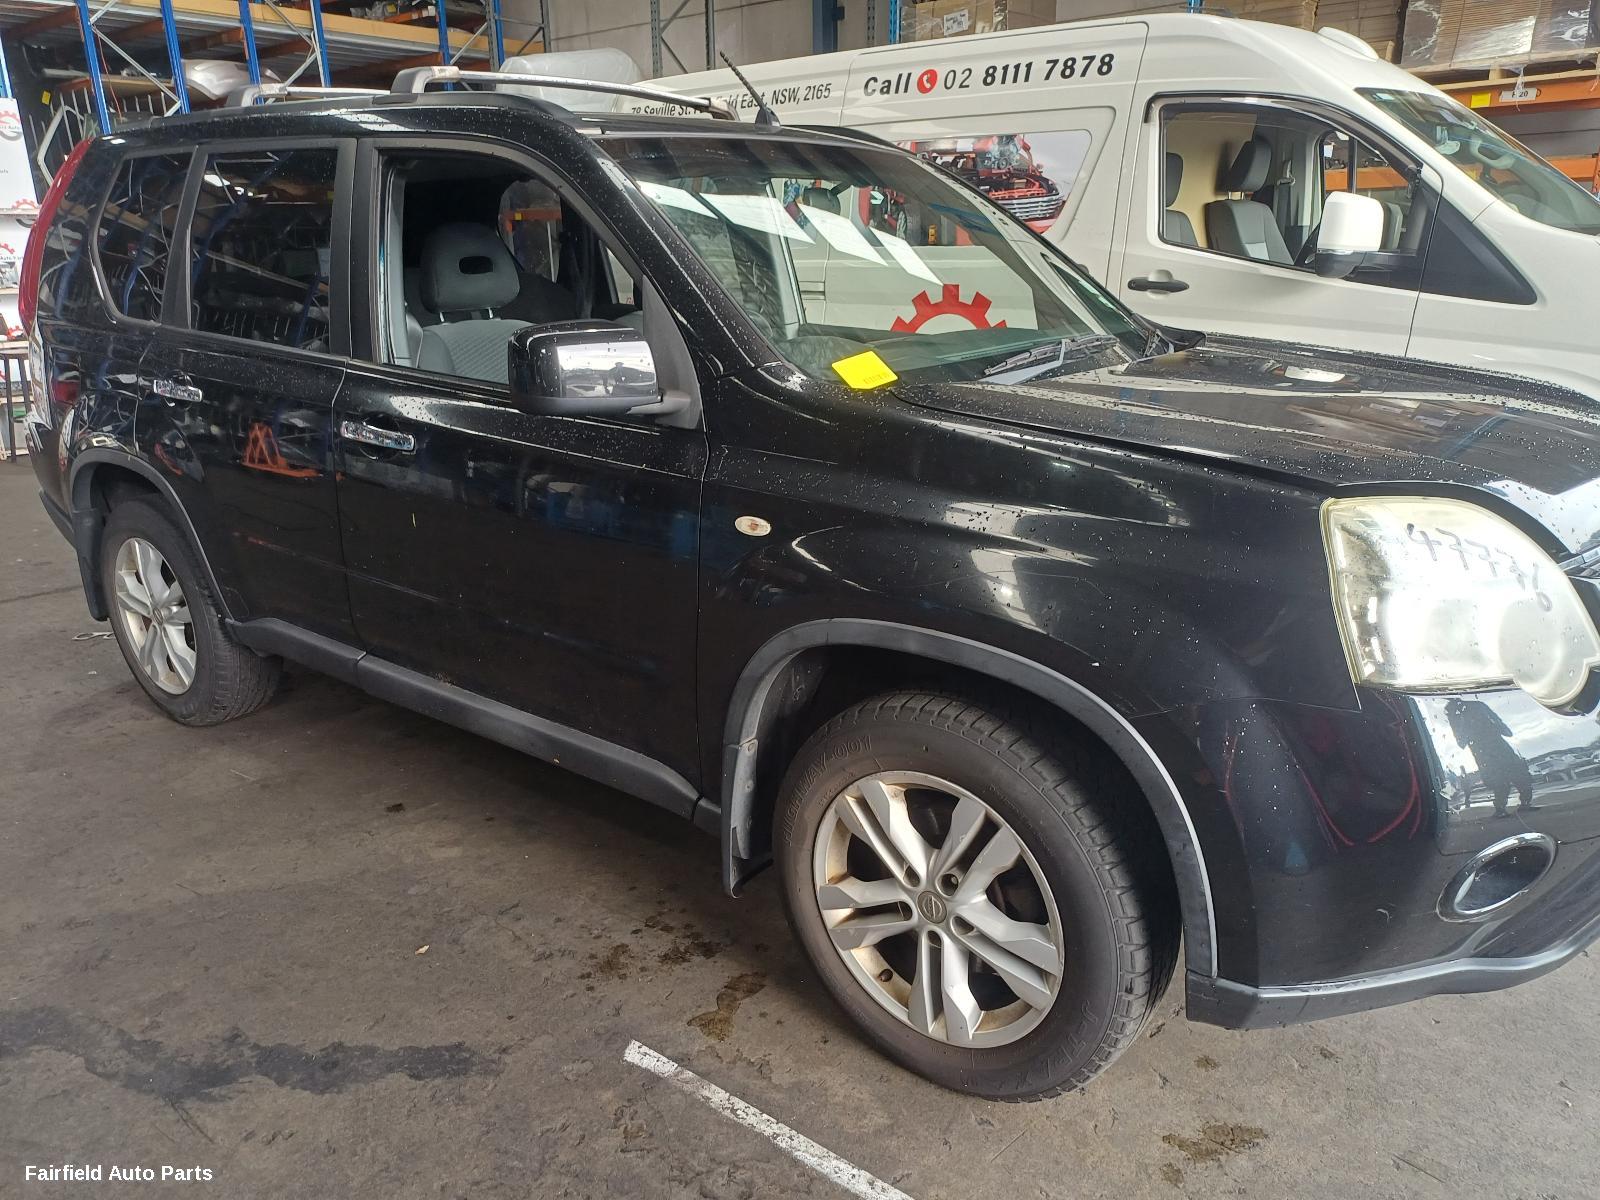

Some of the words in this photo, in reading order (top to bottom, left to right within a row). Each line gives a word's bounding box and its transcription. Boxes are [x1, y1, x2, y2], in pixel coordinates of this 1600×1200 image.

[863, 73, 911, 96] Call
[943, 68, 972, 90] 02
[982, 61, 1032, 87] 8111
[1044, 53, 1114, 81] 7878
[644, 101, 676, 117] Seville
[771, 86, 801, 105] NSW,
[804, 82, 832, 101] 2165
